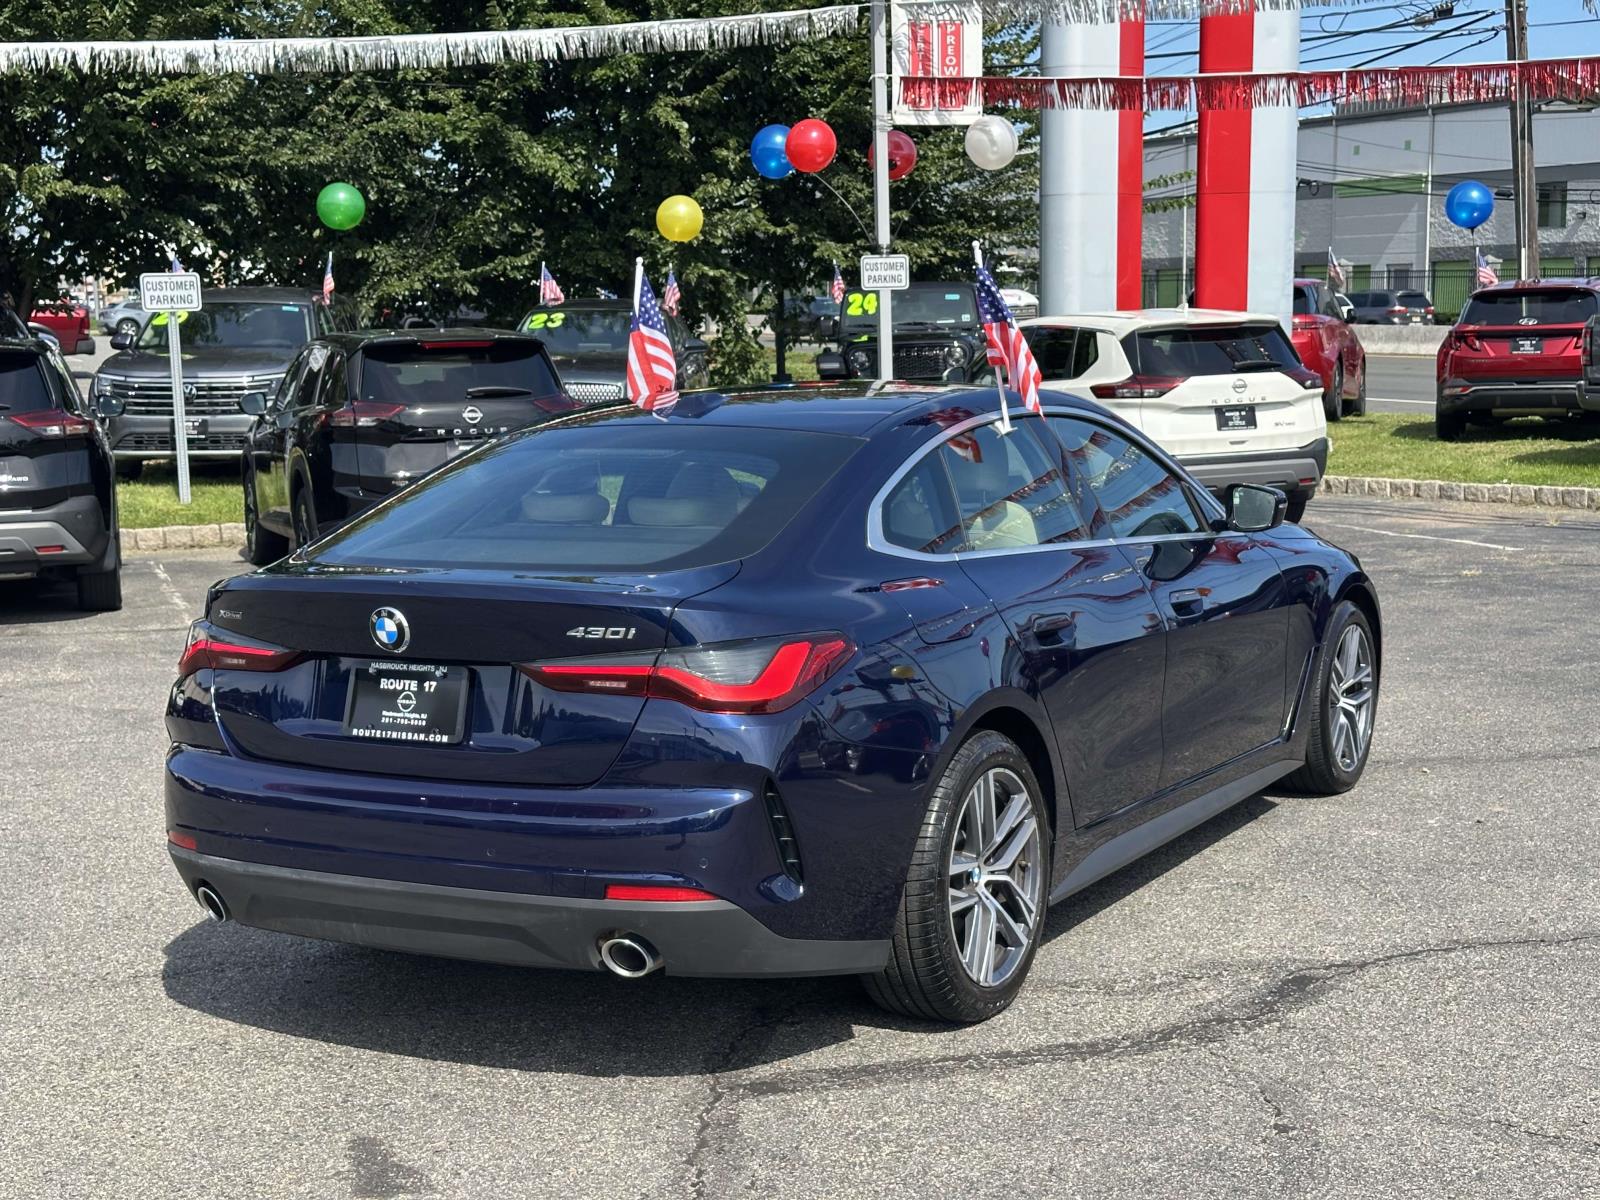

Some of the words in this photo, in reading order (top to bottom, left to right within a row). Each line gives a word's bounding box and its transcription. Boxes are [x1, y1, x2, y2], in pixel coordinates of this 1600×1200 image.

[865, 262, 905, 272] CUSTOMER
[868, 275, 903, 284] PARKING
[145, 280, 195, 292] CUSTOMER
[150, 294, 193, 305] PARKING
[847, 293, 877, 316] 24
[529, 313, 565, 329] 23
[566, 626, 636, 639] 430i
[371, 662, 408, 671] HASBROUCK
[380, 678, 418, 691] ROUTE
[424, 681, 437, 692] 17
[352, 728, 449, 742] ROUTE17NISSAN.COM
